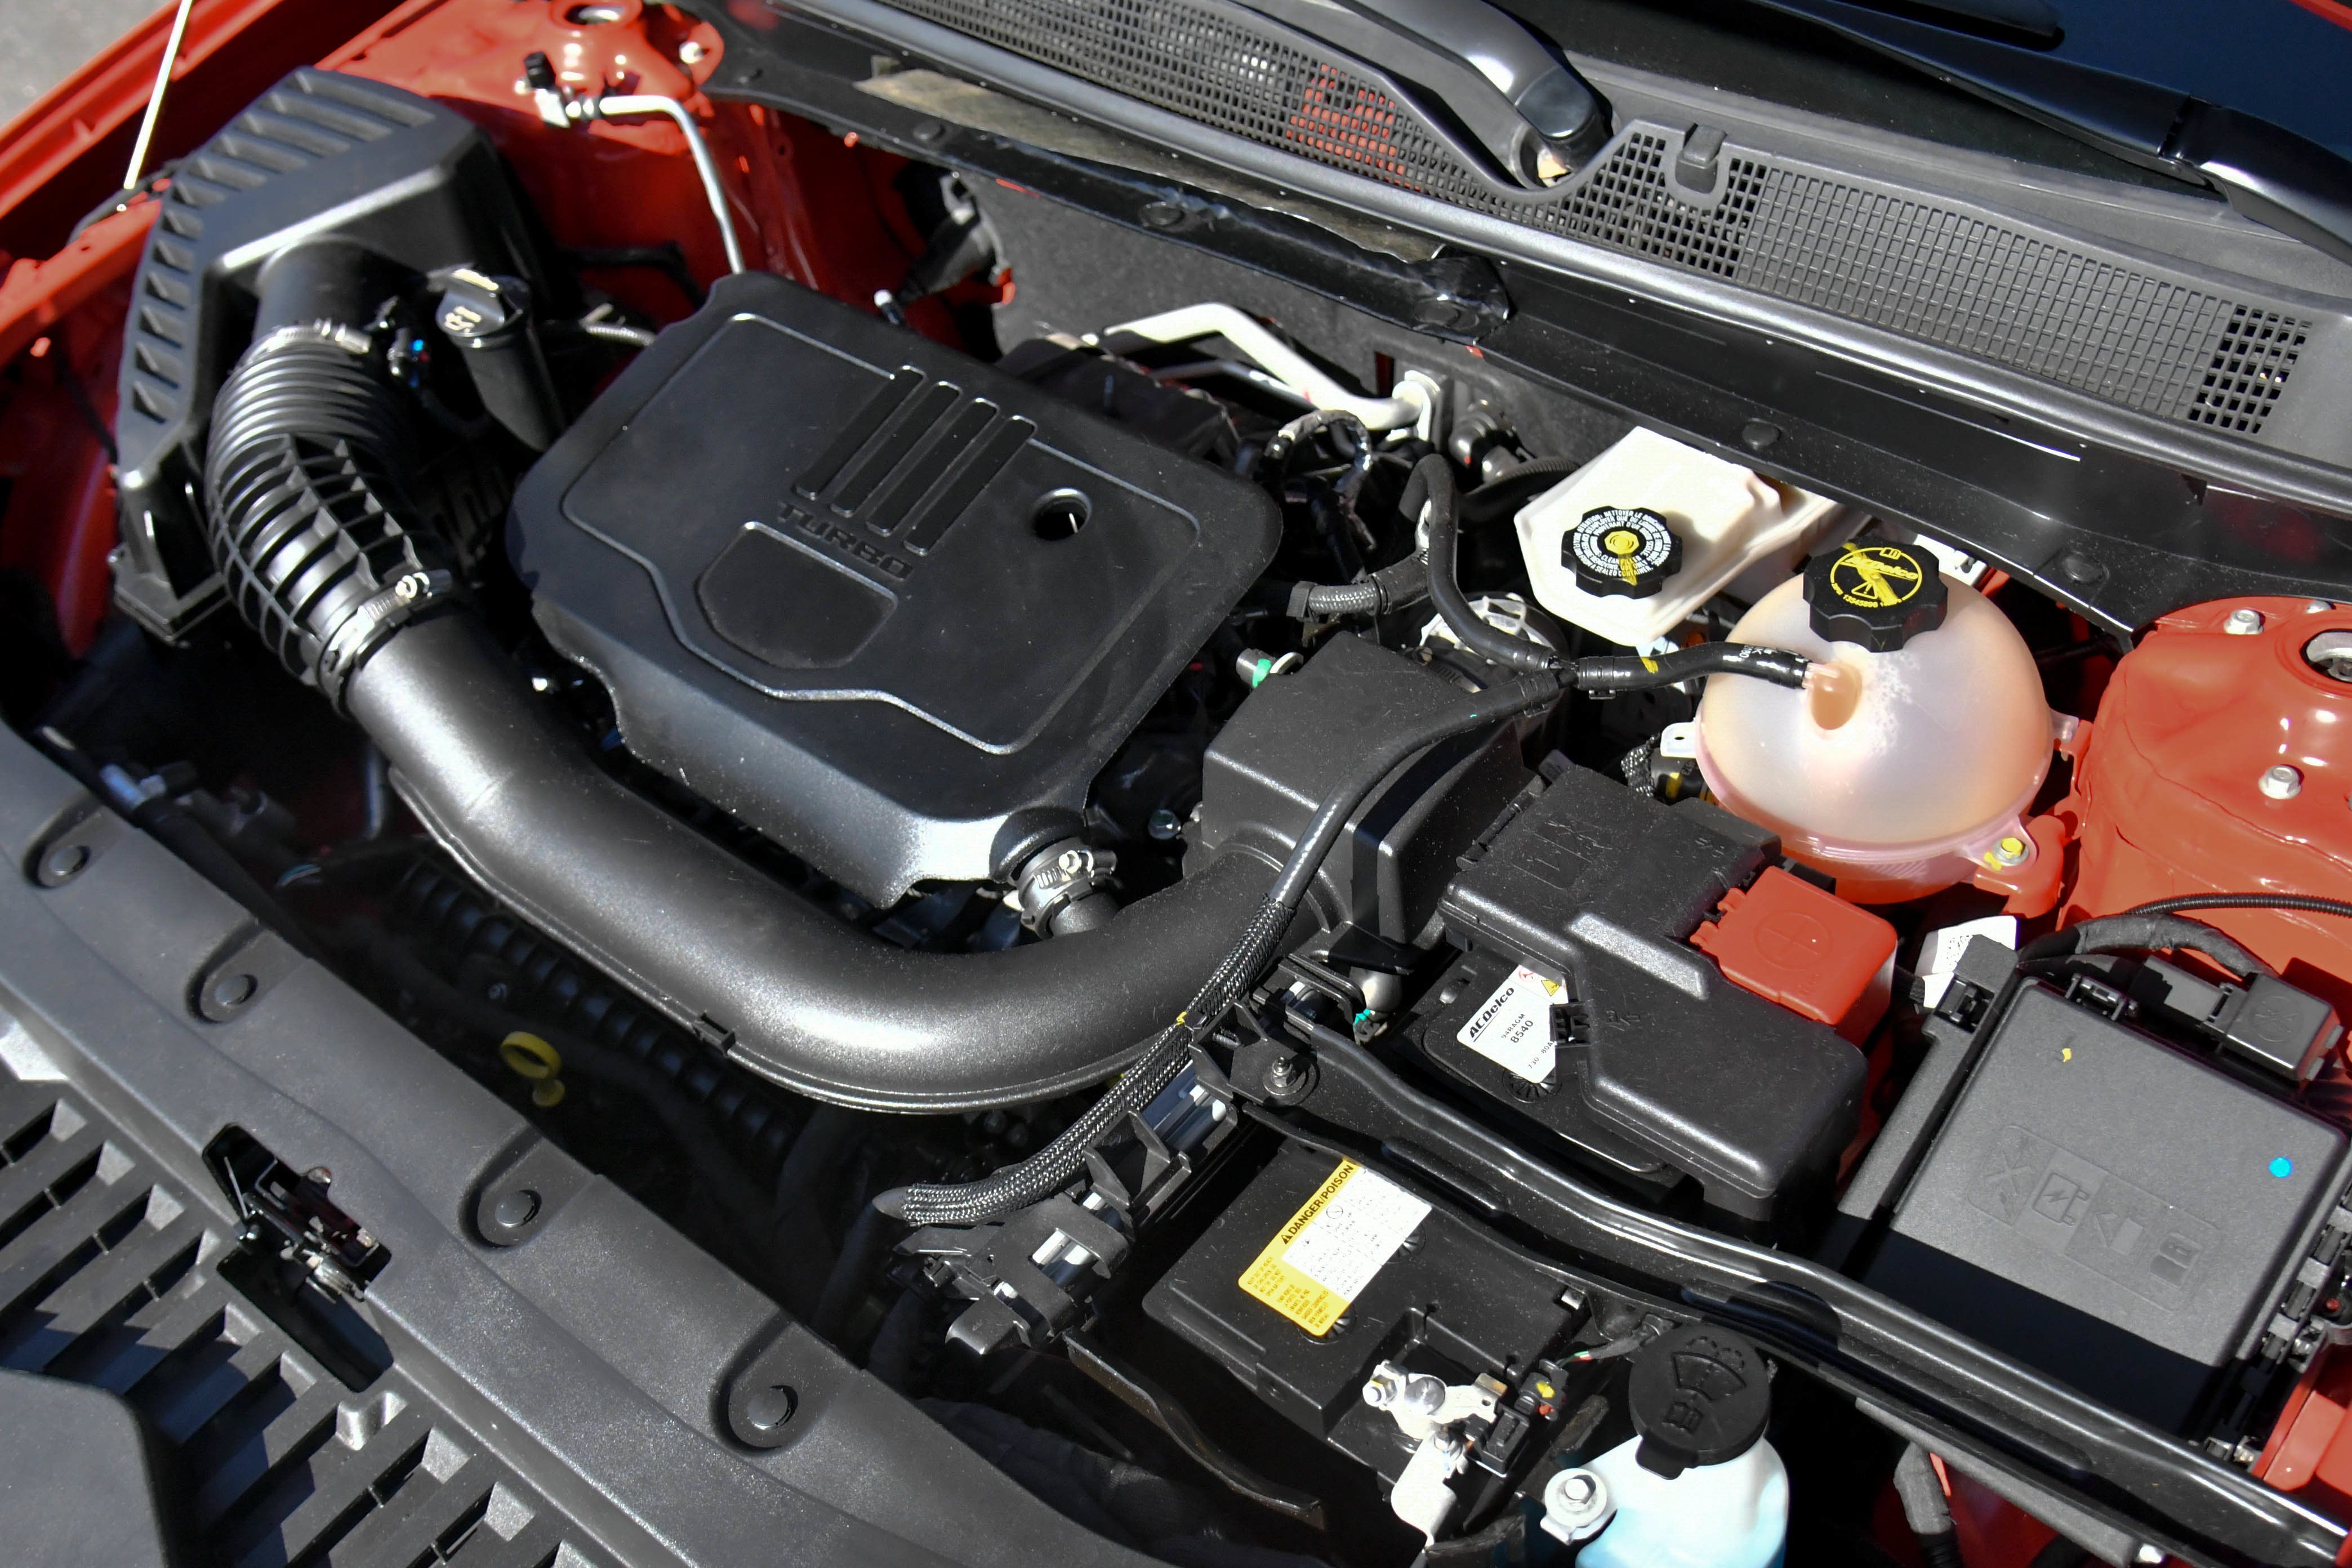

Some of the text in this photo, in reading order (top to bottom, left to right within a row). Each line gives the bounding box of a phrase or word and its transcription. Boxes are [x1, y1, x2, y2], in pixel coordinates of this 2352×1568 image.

[777, 501, 914, 581] TURBO
[1469, 987, 1514, 1039] ACDelco
[1511, 1020, 1534, 1043] 8540
[1288, 1164, 1354, 1236] DANGER/POISON
